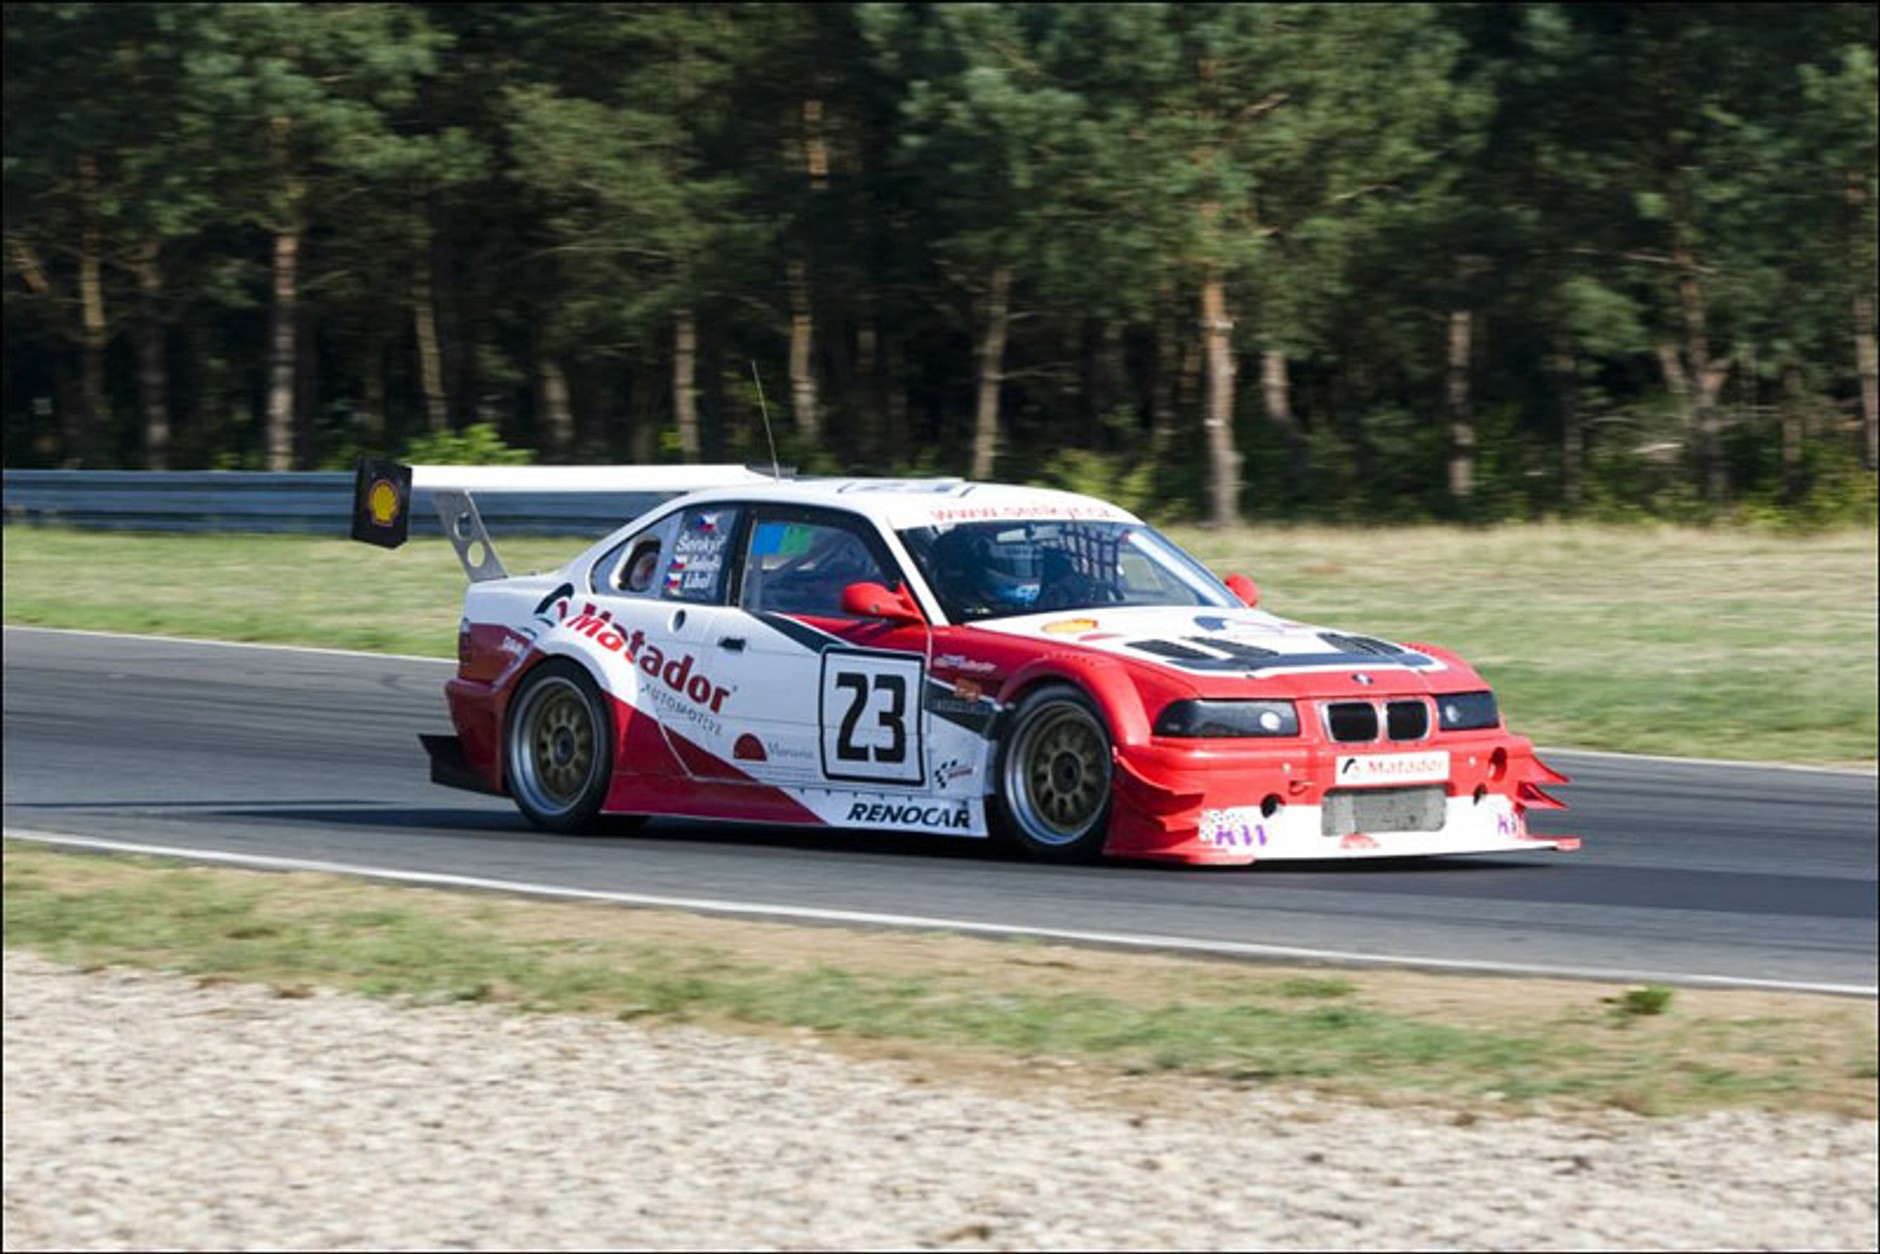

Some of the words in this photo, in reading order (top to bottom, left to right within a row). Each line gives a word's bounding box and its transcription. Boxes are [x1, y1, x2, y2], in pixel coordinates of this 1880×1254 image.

[567, 602, 730, 714] Matador
[640, 683, 723, 737] AUTOMOTIVE
[836, 671, 906, 764] 23
[1367, 757, 1443, 775] Matador
[846, 802, 971, 829] RENOCAR
